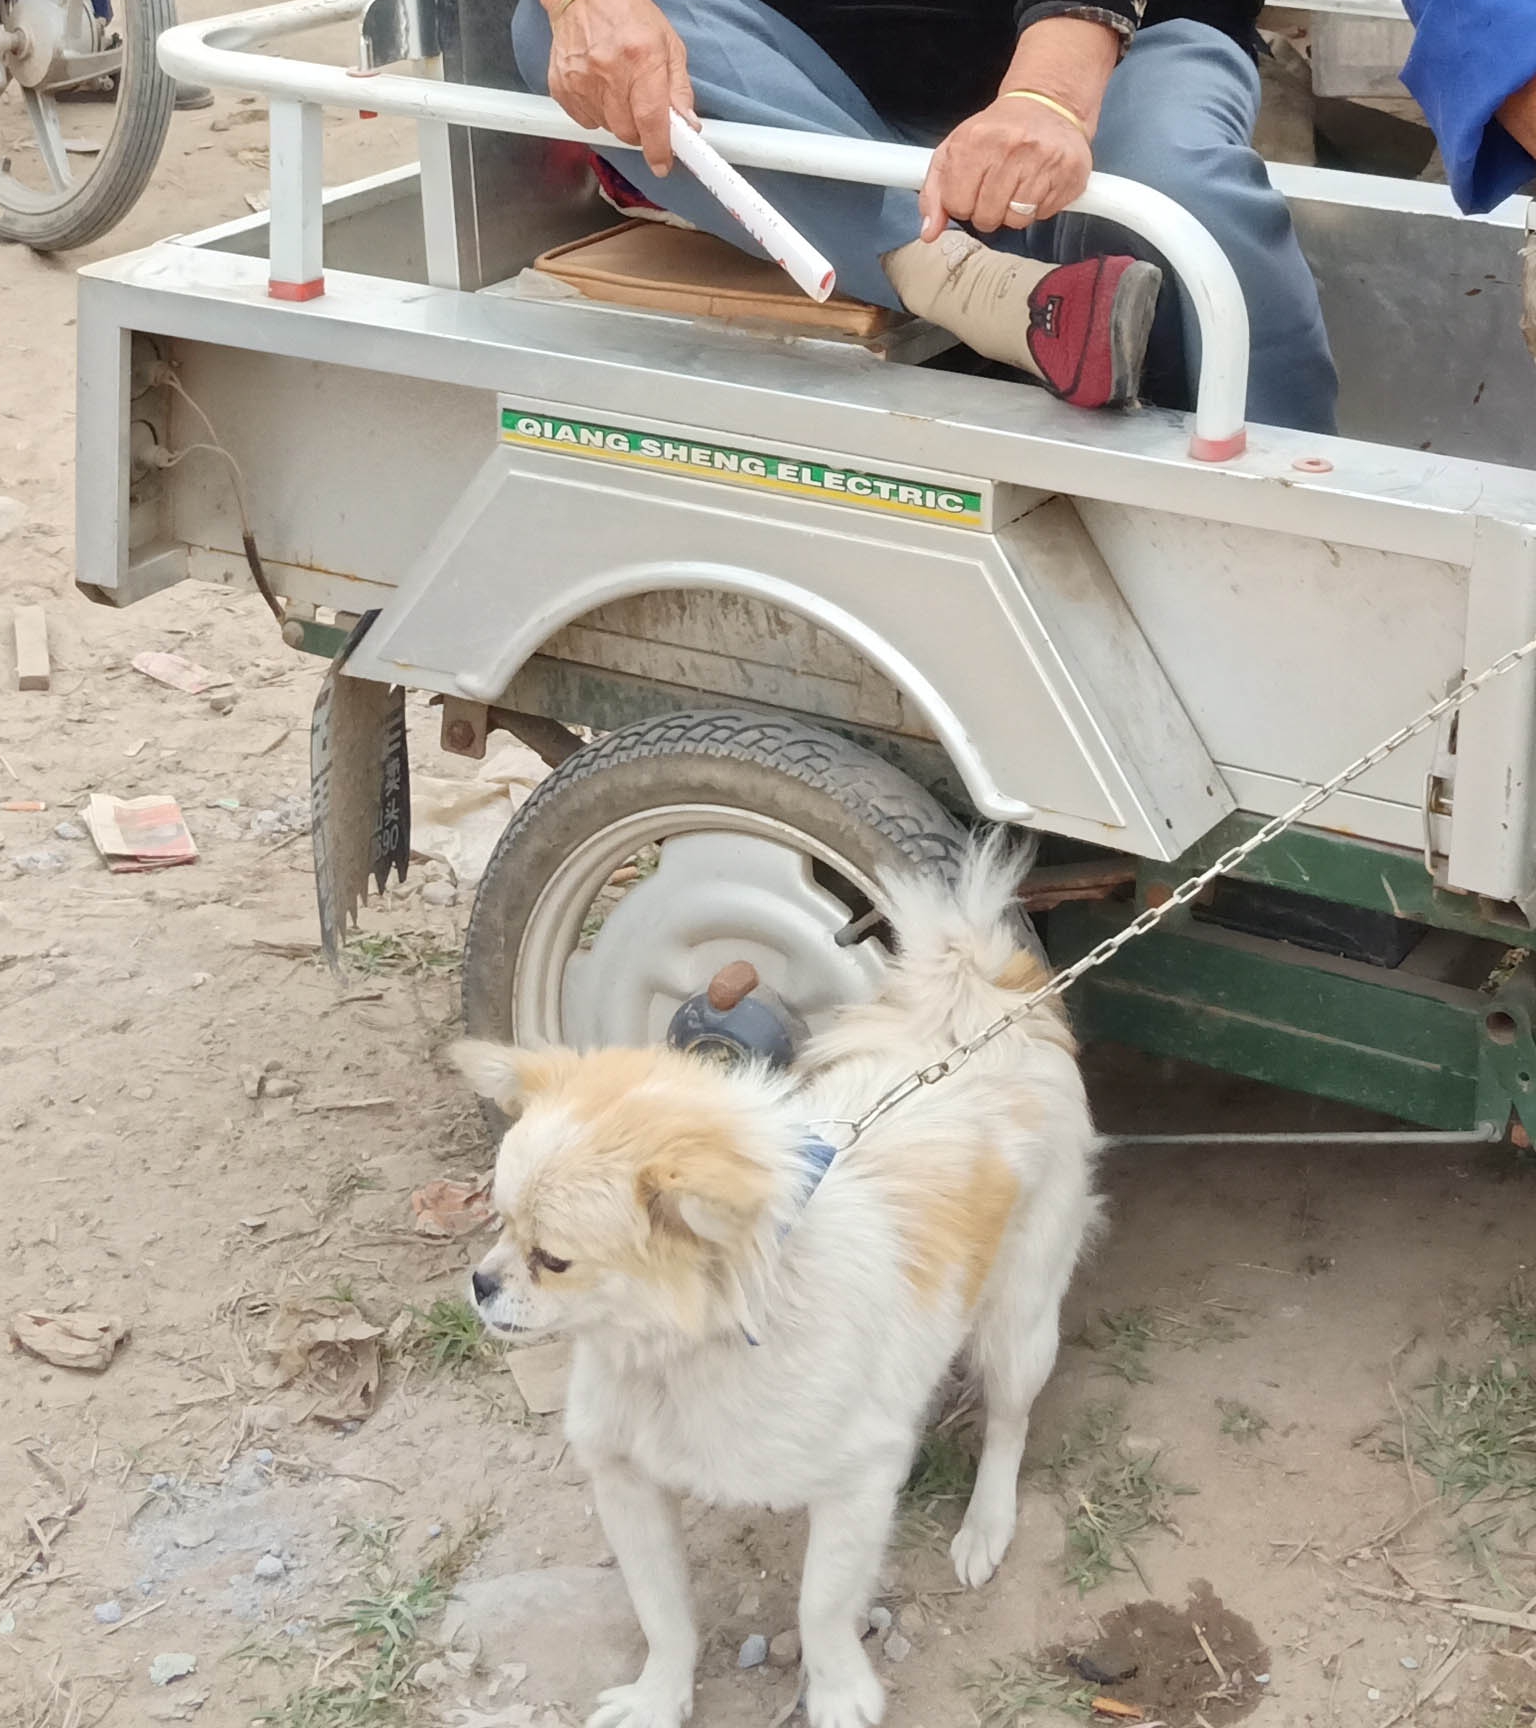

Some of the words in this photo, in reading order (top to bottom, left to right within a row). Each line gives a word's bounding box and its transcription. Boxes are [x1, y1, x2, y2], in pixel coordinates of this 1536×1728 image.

[516, 416, 632, 455] QIANG
[637, 437, 769, 478] SHENG
[775, 462, 965, 513] ELECTRIC
